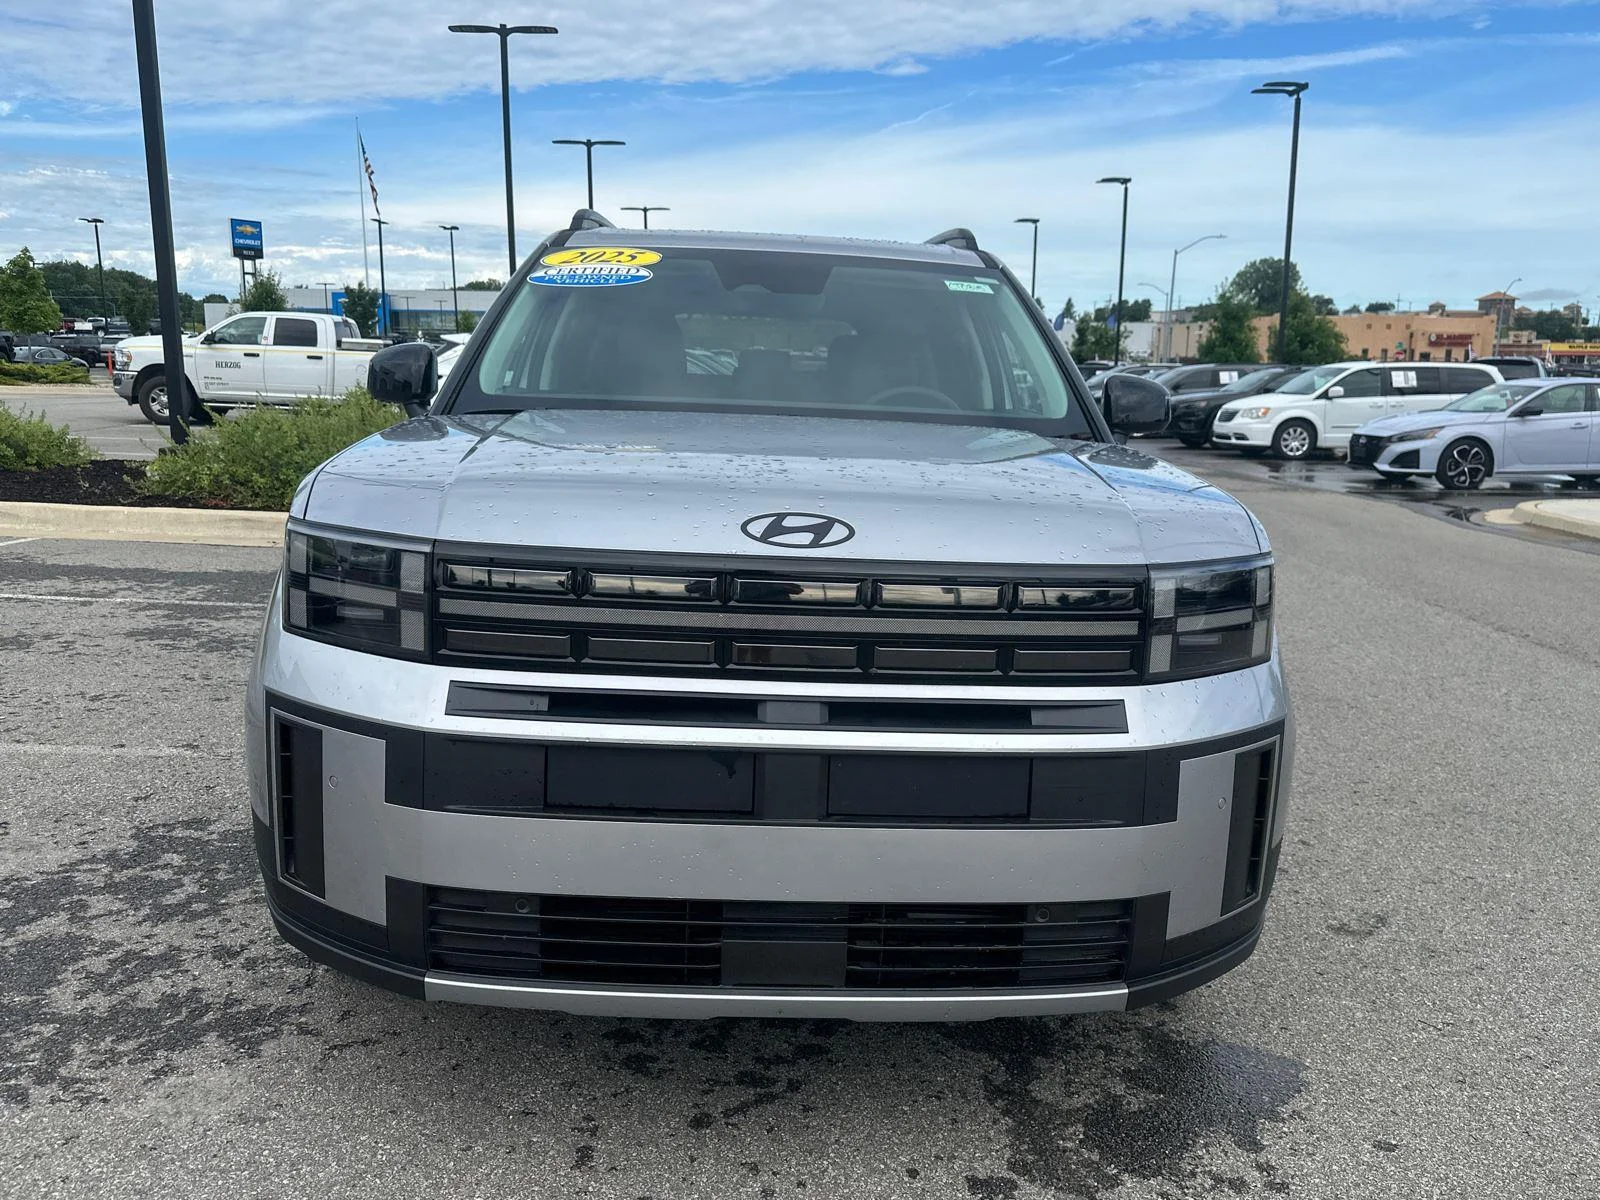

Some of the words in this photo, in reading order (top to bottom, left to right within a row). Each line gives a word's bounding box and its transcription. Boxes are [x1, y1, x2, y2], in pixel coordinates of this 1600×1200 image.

[558, 251, 645, 264] 2025
[544, 266, 640, 275] CERTIFIED
[215, 360, 241, 369] HERZOG
